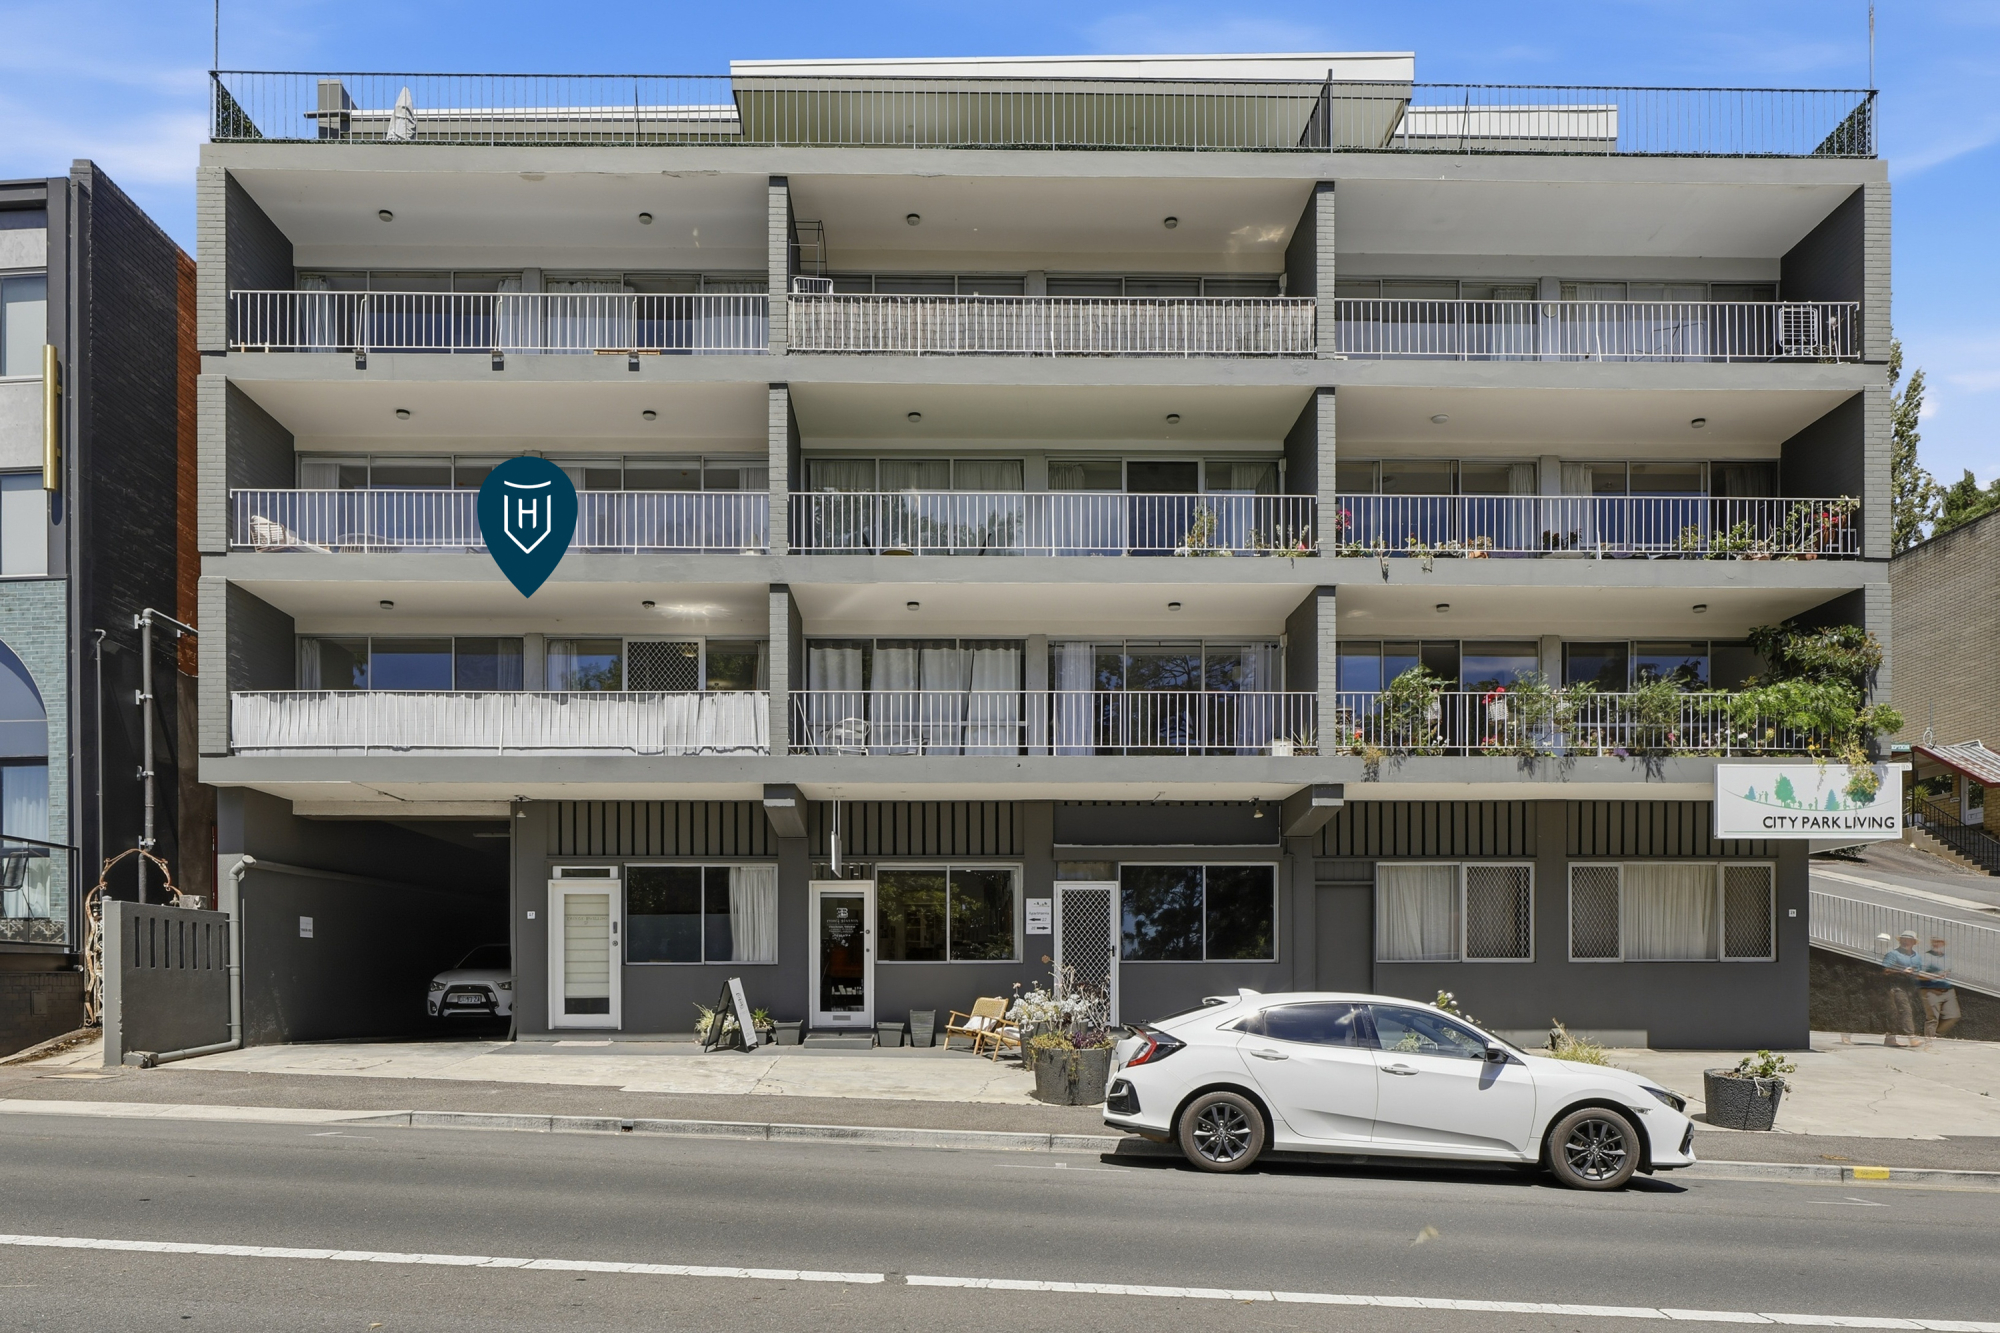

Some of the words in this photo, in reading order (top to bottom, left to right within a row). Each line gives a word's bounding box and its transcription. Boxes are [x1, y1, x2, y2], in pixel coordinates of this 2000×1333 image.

[1763, 816, 1798, 829] CITY
[1802, 816, 1841, 829] PARK
[1844, 816, 1895, 829] LIVING
